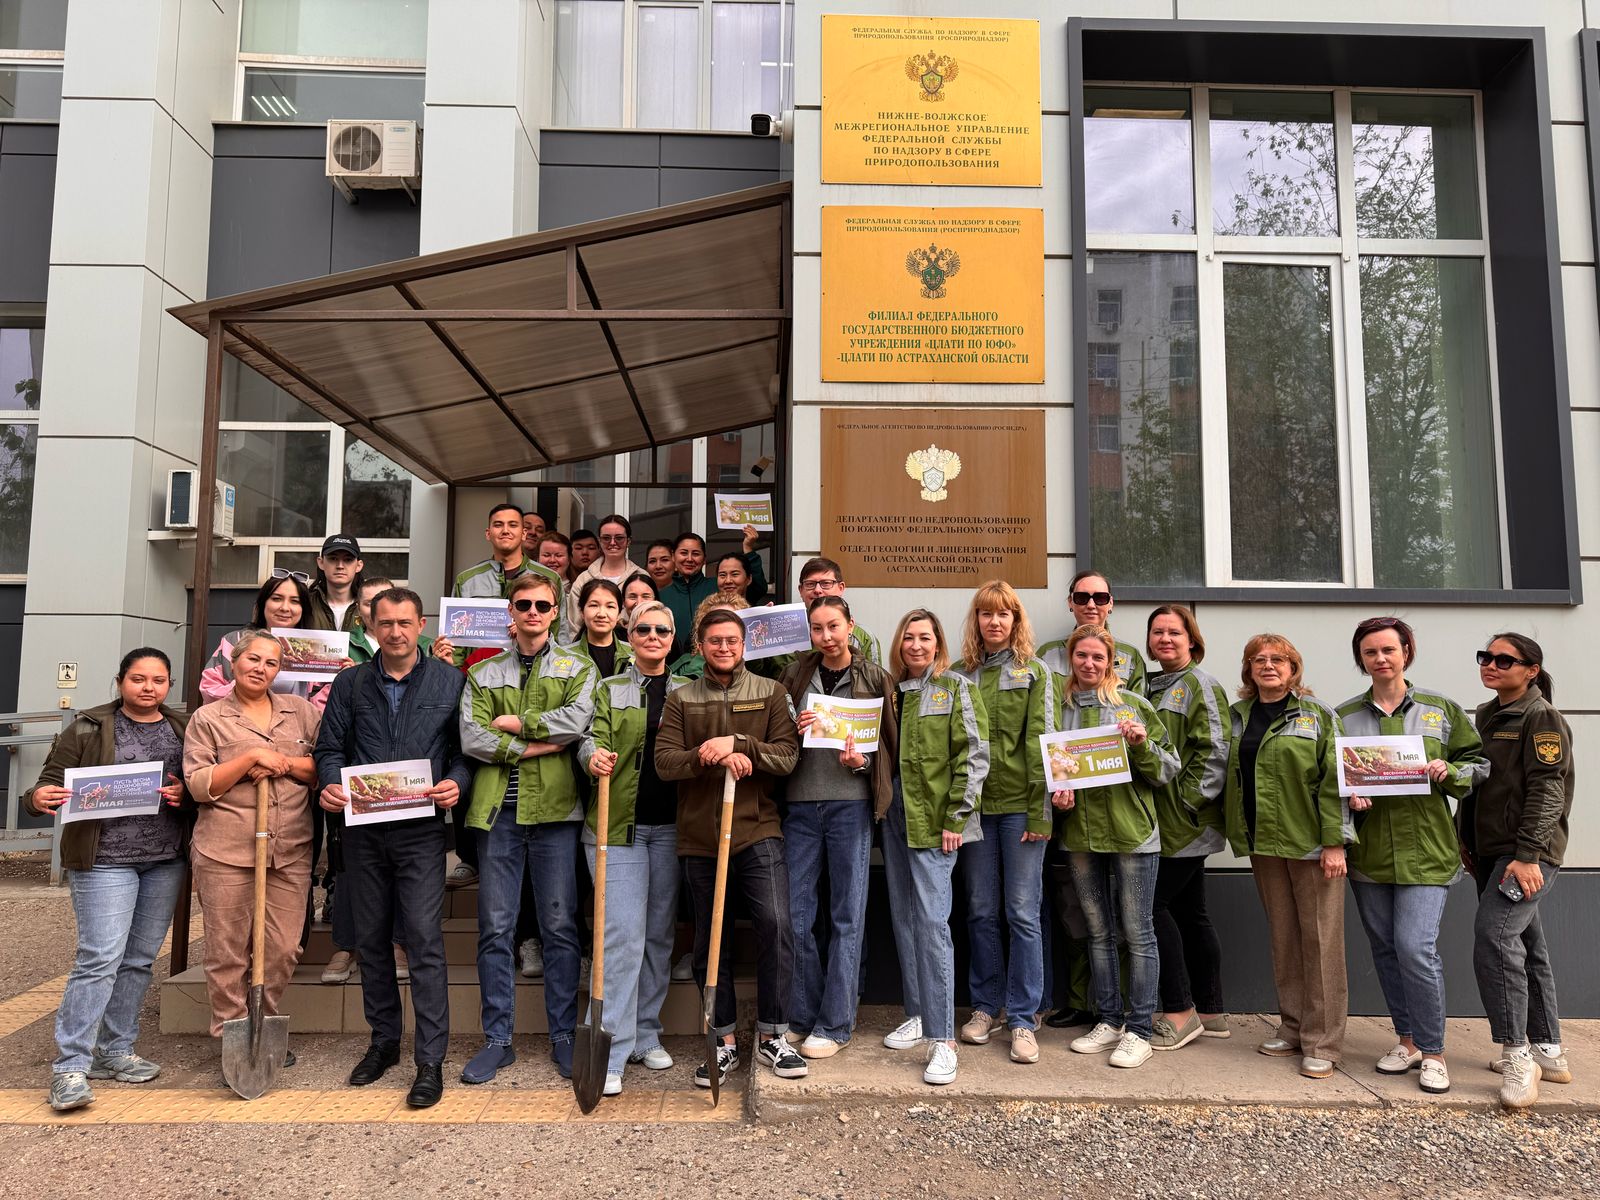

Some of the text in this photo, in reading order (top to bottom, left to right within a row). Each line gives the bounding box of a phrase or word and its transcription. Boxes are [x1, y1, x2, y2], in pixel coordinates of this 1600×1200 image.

[878, 112, 987, 121] НИЖНЕ-ВОЛЖСКОЕ
[834, 123, 1030, 134] МЕЖРЕГИОНАЛЬНОЕ УПРАВЛЕНИЕ
[863, 134, 1001, 145] ФЕДЕРАЛЬНОЙ СЛУЖБЫ
[892, 147, 941, 156] НАДЗОРУ
[955, 148, 991, 156] СФЕРЕ
[865, 158, 999, 168] ПРИРОДОПОЛЬЗОВАНИЯ
[868, 311, 998, 322] ФИЛИАЛ ФЕДЕРАЛЬНОГО
[842, 325, 1024, 336] ГОСУДАРСТВЕННОГО БЮДЖЕТНОГО
[850, 339, 1016, 350] УЧРЕЖДЕНИЯ «ЦЛАТИ ПО ЮФО»
[837, 351, 1029, 364] -ЦЛАТИ ПО АСТРАХАНСКОЙ ОБЛАСТИ
[744, 511, 769, 522] 1 МАЯ
[836, 516, 1030, 525] ДЕПАРТАМЕНТ ПО НЕДРОПОЛЬЗОВАНИЮ
[841, 525, 1025, 534] ПО ЮЖНОМУ ФЕДЕРАЛЬНОМУ ОКРУГУ
[840, 545, 872, 553] ОТДЕЛ
[874, 545, 924, 553] ГЕОЛОГИИ
[936, 546, 1027, 554] ЛИЦЕНЗИРОВАНИЯ
[864, 554, 1003, 564] ПО АСТРАХАНСКОЙ ОБЛАСТИ
[887, 565, 979, 574] (АСТРАХАНЬНЕДРА)
[766, 637, 783, 645] МАЯ
[854, 728, 876, 739] МАЯ
[1397, 752, 1401, 760] 1
[1086, 755, 1124, 771] 1 МАЯ
[403, 776, 408, 785] 1
[100, 800, 123, 808] МАЯ
